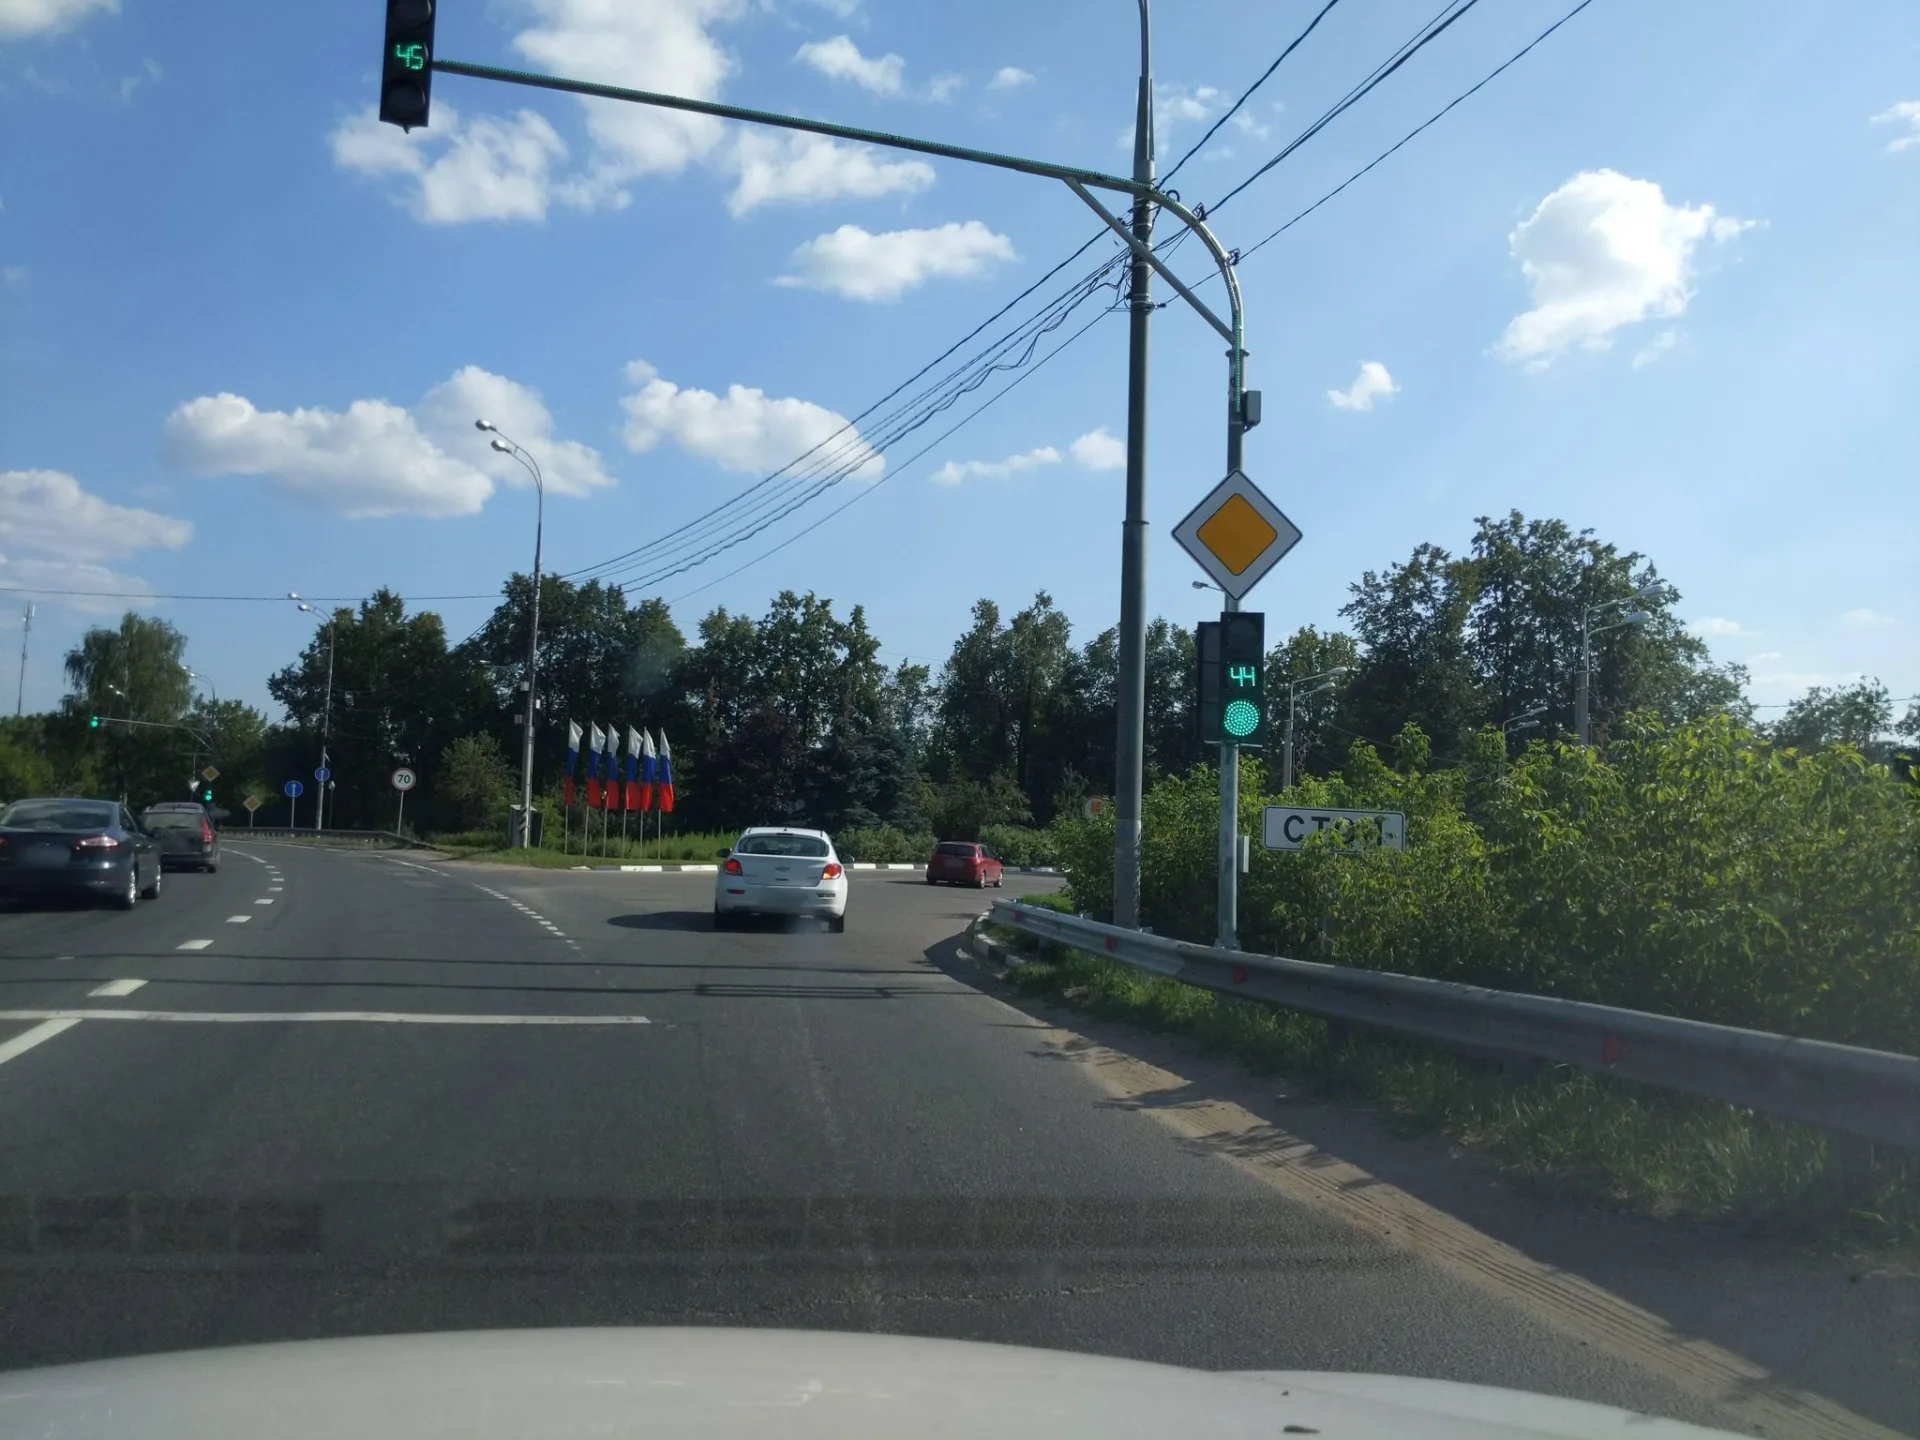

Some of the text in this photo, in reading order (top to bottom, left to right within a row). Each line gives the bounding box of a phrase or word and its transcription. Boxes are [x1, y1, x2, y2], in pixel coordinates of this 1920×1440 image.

[396, 44, 423, 70] 45
[1230, 666, 1256, 687] 44
[397, 774, 411, 784] 70
